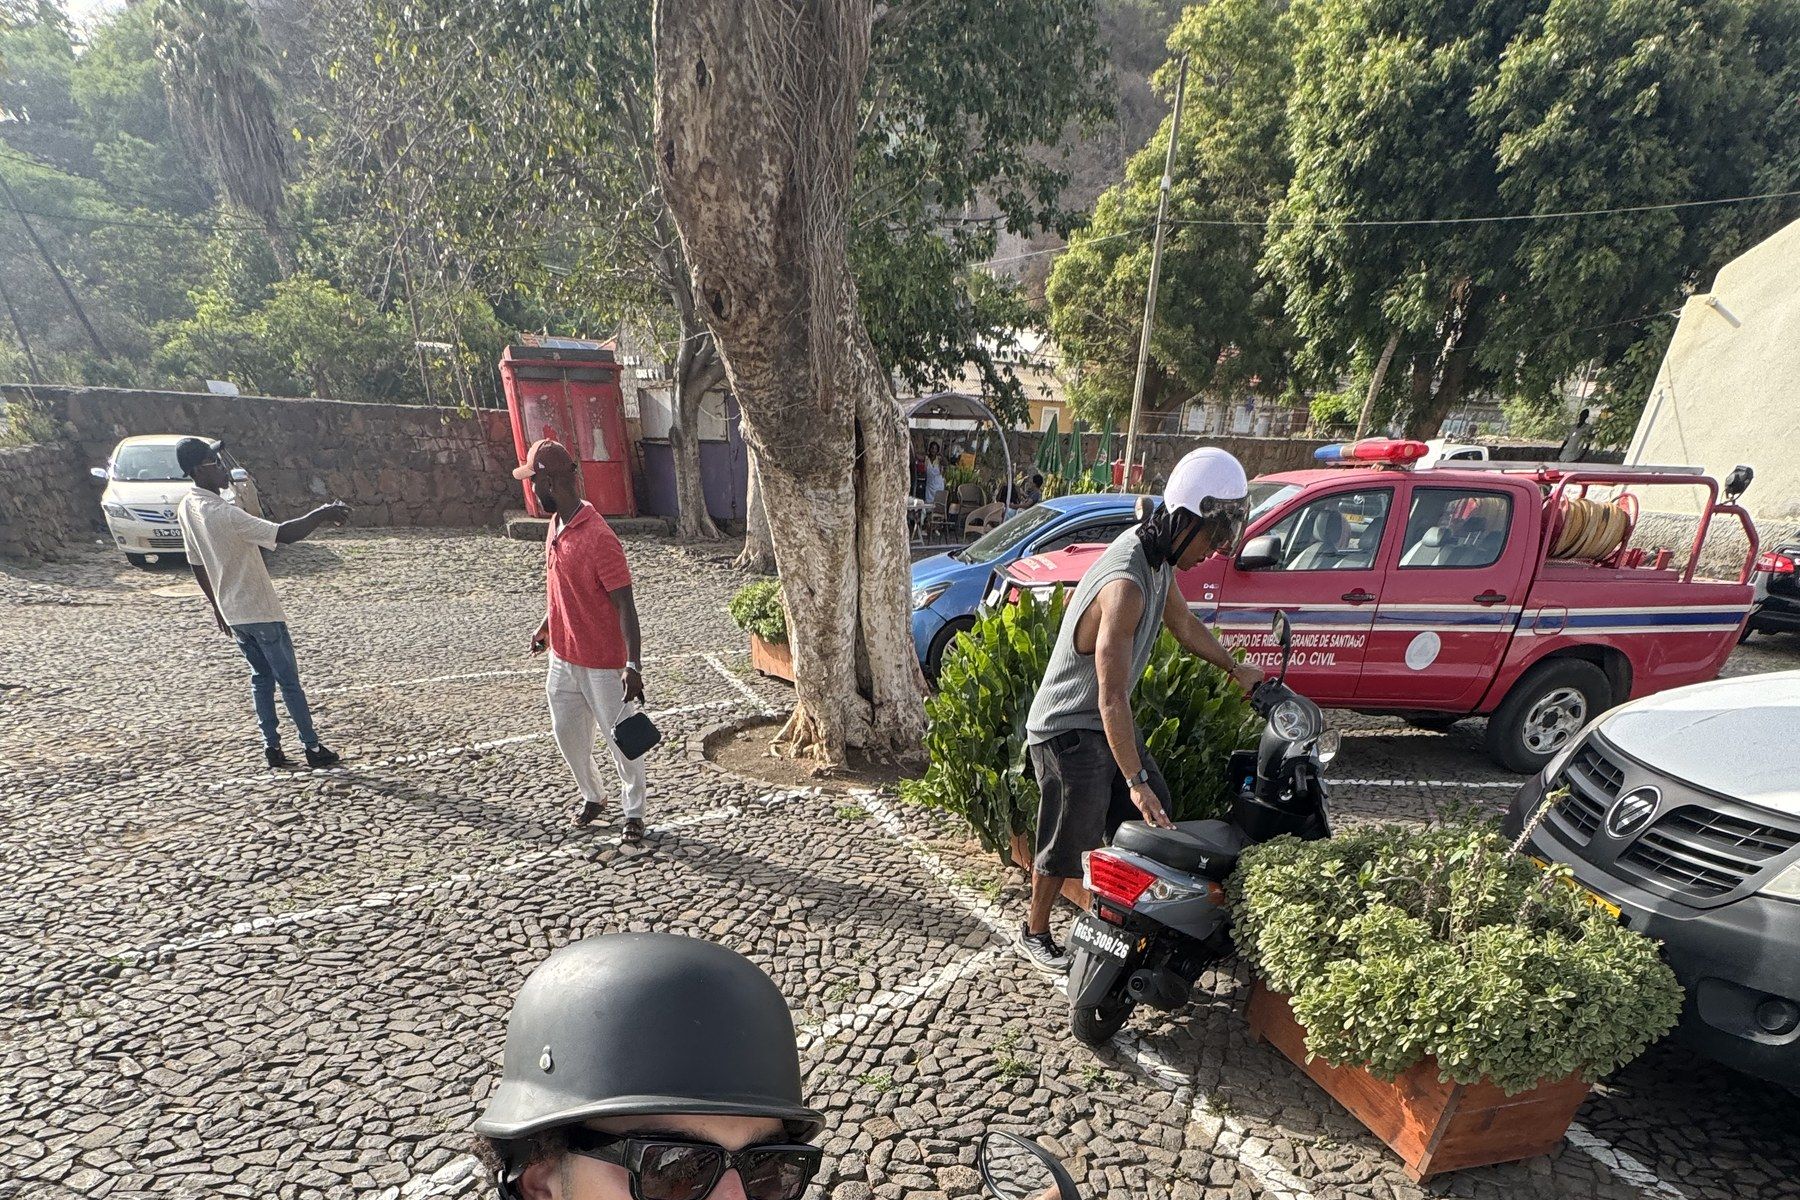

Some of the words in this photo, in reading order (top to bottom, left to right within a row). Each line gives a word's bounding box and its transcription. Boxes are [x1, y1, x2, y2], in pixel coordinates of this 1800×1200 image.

[1251, 634, 1262, 647] DE
[1290, 634, 1320, 648] GRANDE
[1319, 634, 1330, 648] DE
[1309, 651, 1336, 666] CIVIL
[1073, 922, 1130, 959] RGS-308/26
